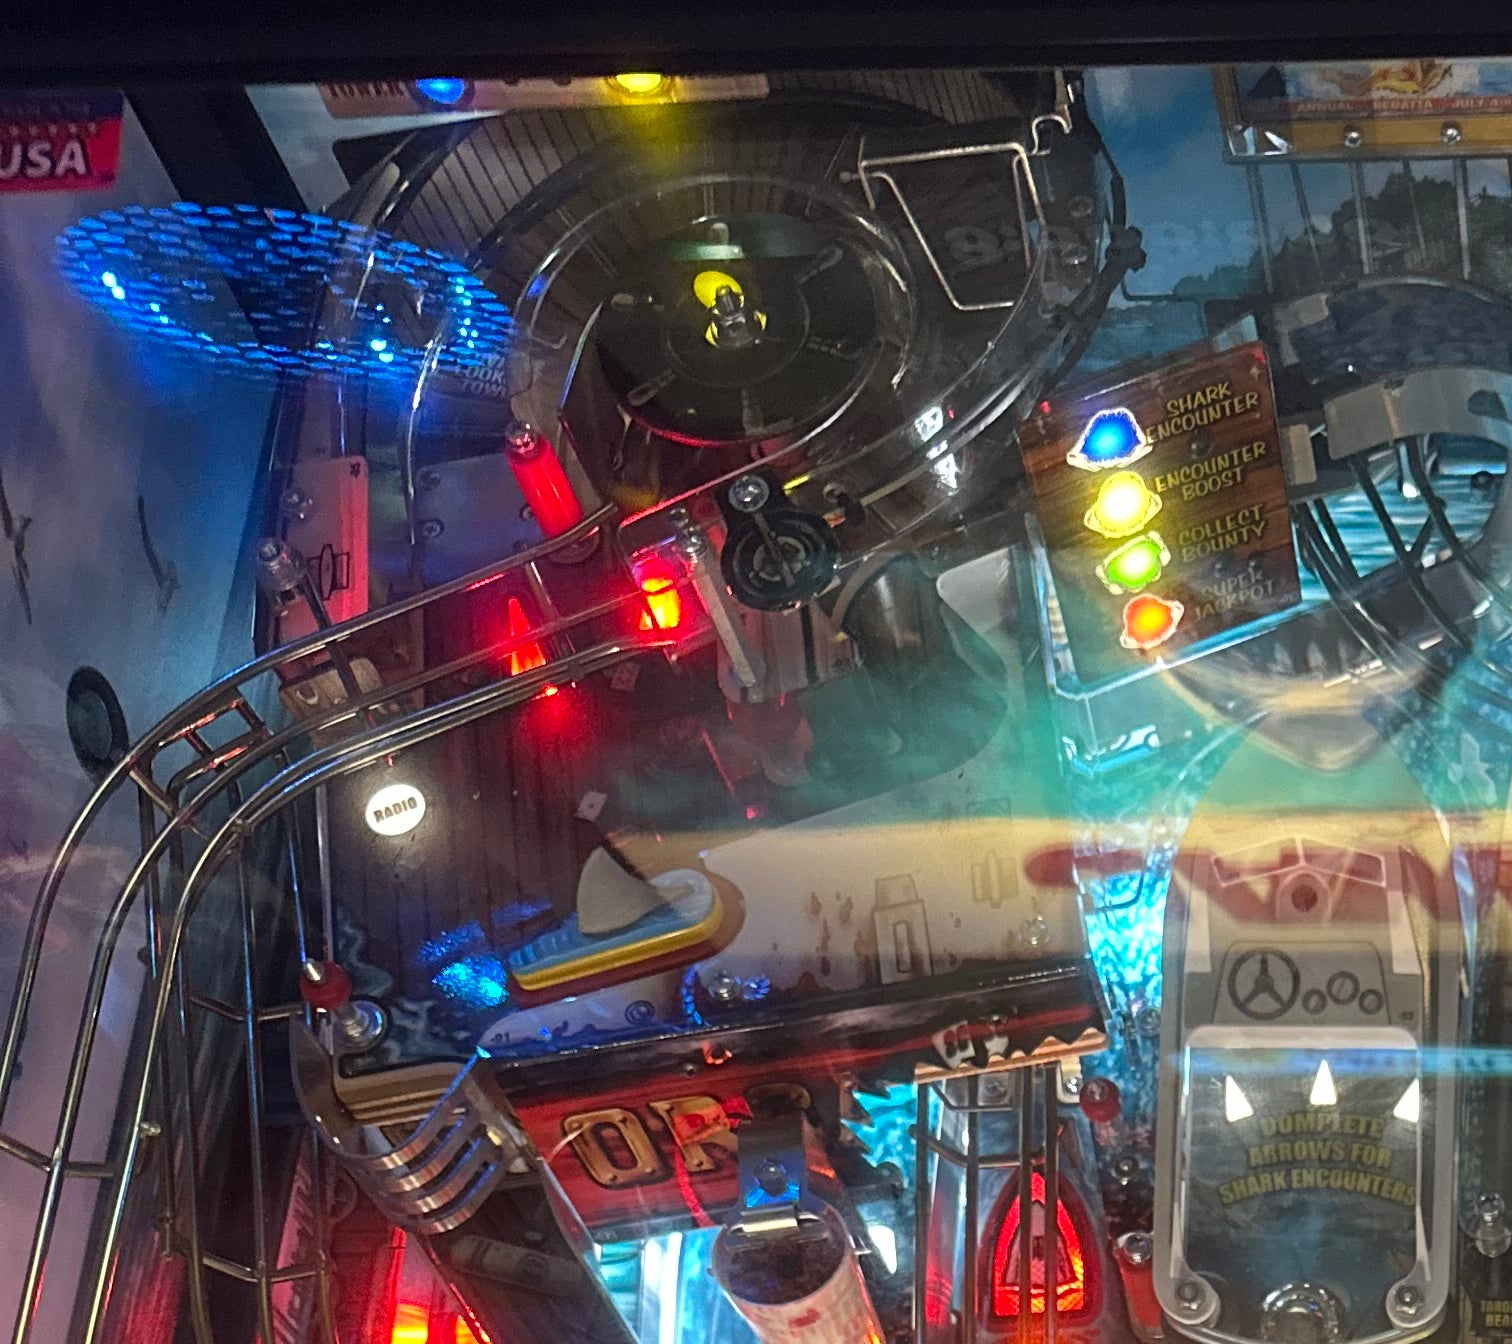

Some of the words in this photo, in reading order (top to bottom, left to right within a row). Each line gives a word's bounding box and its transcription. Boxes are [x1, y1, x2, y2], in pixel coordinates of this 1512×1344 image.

[1146, 391, 1259, 444] ENCOUNTER
[1167, 382, 1232, 417] SHARK
[1155, 441, 1266, 493] ENCOUNTER
[1182, 467, 1244, 501] BOOST
[1178, 504, 1264, 546] COLLECT
[1182, 521, 1266, 563] BOUNTY
[1195, 580, 1274, 624] JACKPOT
[1201, 566, 1264, 602] SUPER
[373, 796, 418, 823] RADIO
[1260, 1111, 1384, 1138] COMPLETE
[1248, 1140, 1346, 1167] ARROWS
[1351, 1143, 1393, 1169] FOR
[1218, 1170, 1288, 1205] SHARK
[1291, 1168, 1417, 1206] ENCOUNTERS
